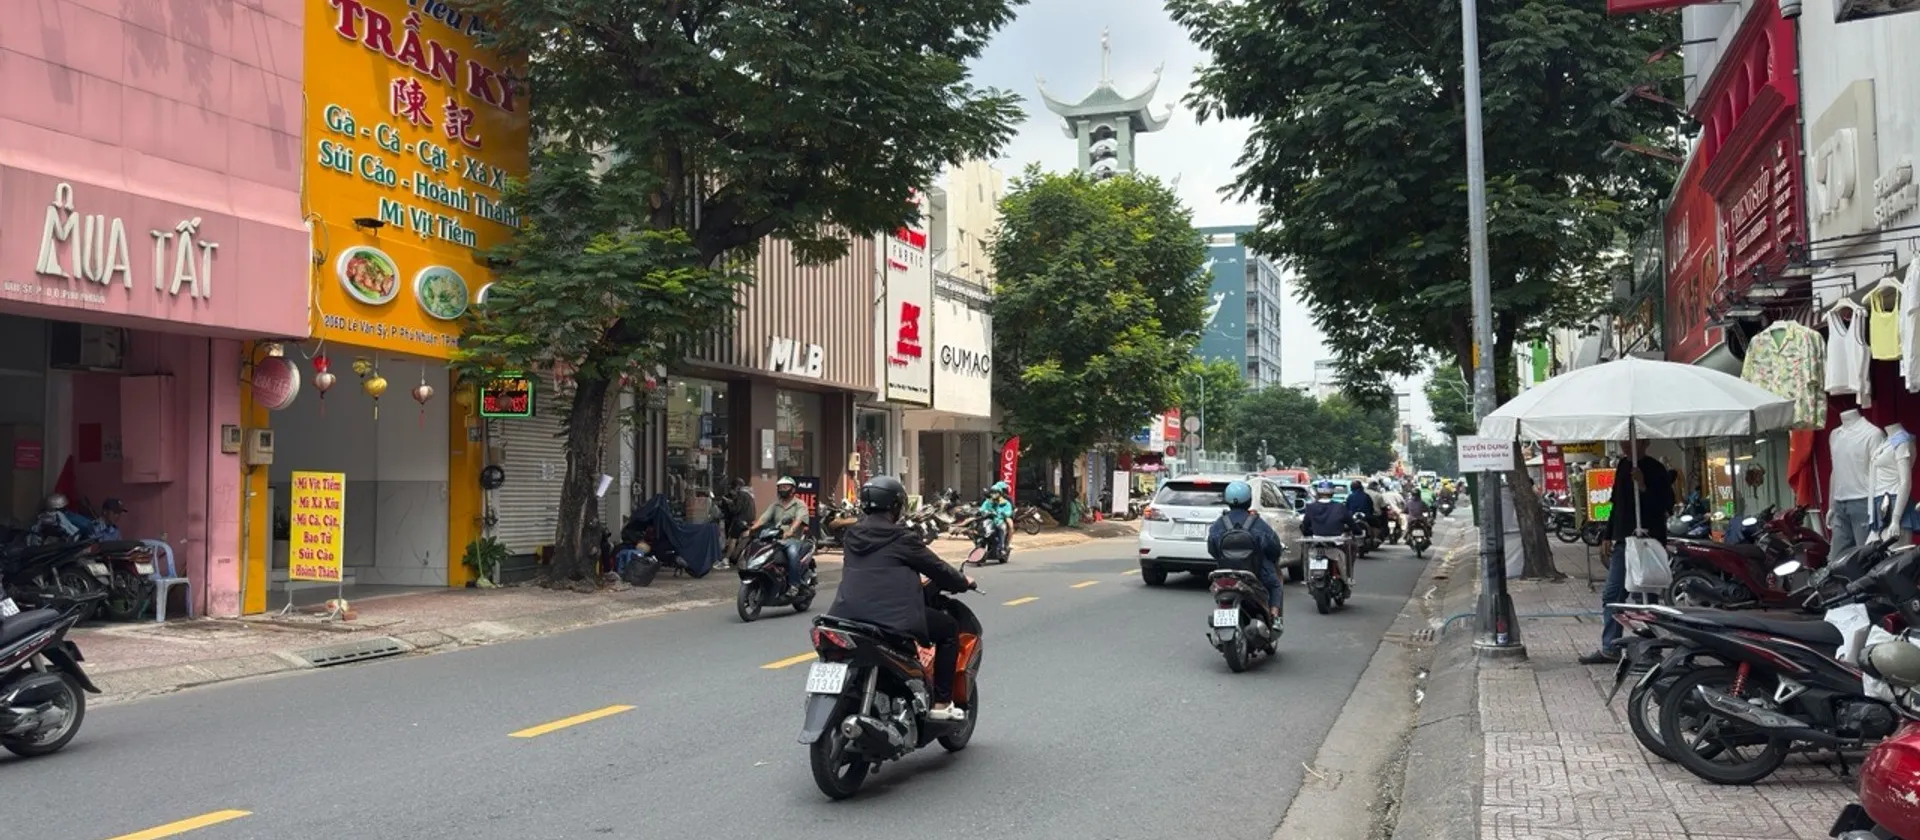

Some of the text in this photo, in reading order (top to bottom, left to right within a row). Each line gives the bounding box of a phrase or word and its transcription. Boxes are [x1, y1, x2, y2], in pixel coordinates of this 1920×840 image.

[330, 0, 459, 86] TRẦN
[324, 103, 355, 138] Gà
[375, 122, 401, 153] Cá
[416, 140, 449, 173] Cật
[463, 155, 488, 185] Xá
[390, 76, 482, 148] 陳記
[318, 140, 353, 174] Sủi
[359, 153, 397, 187] Cảo
[414, 171, 470, 211] Hoành
[473, 192, 521, 228] Thánh
[379, 197, 404, 227] Mì
[409, 207, 434, 239] Vịt
[36, 183, 219, 300] MUA TẤT
[769, 336, 823, 378] MLB
[941, 345, 990, 373] GUMAC
[303, 531, 319, 544] Bao
